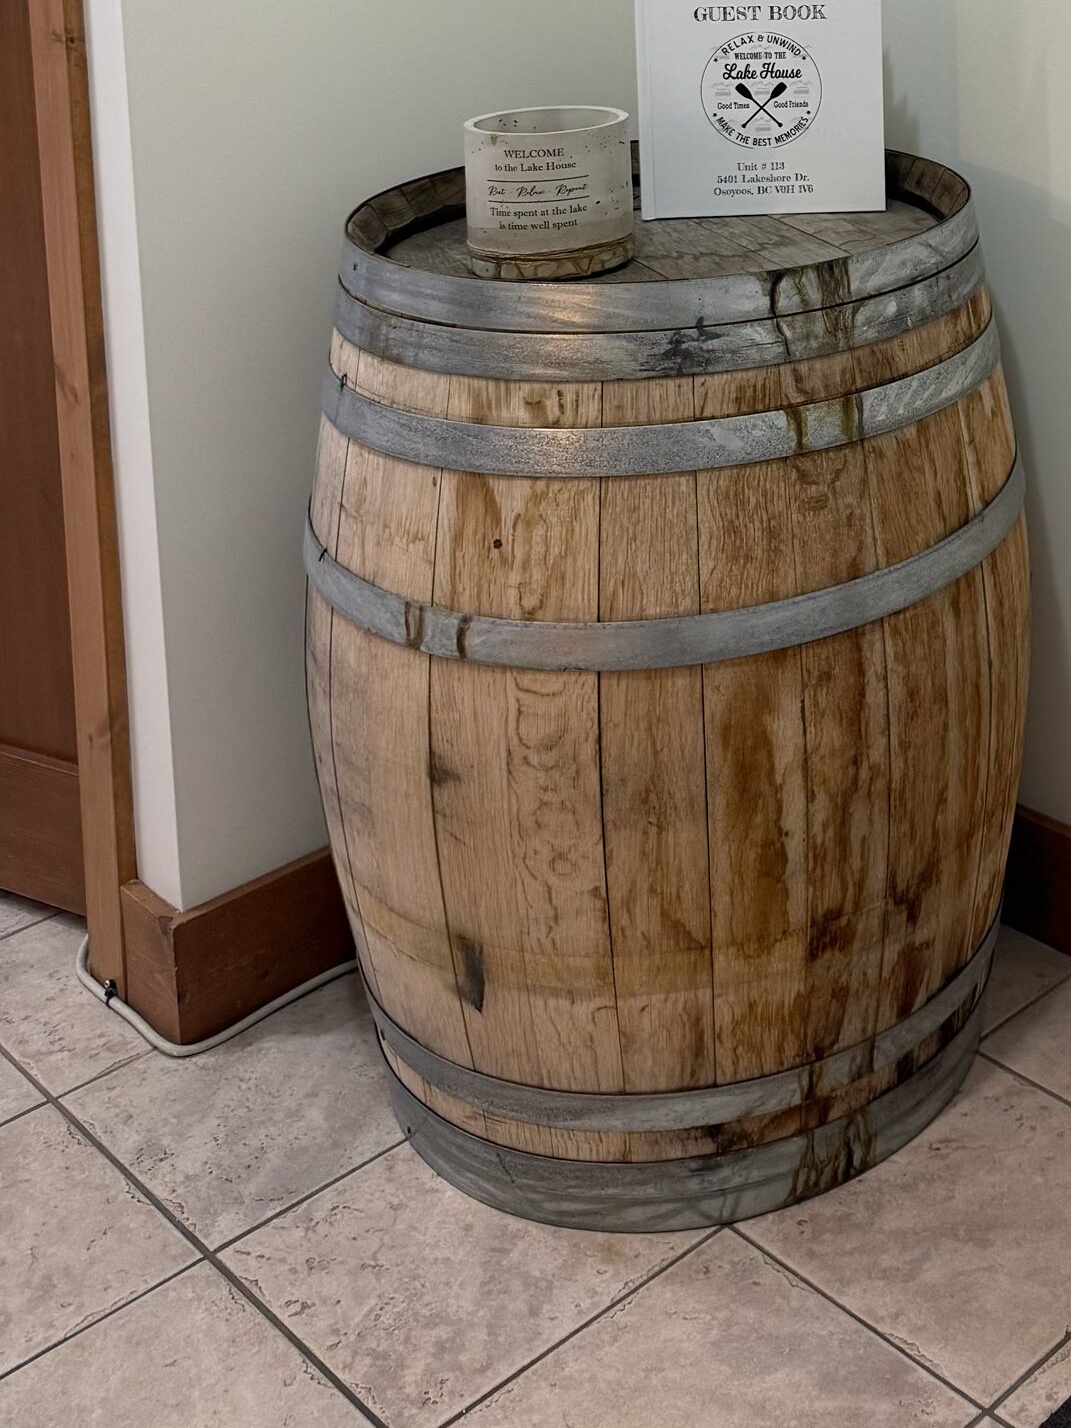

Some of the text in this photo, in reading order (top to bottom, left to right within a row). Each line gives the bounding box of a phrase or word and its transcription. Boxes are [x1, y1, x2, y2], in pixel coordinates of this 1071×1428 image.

[693, 4, 828, 22] GUEST BOOK
[721, 34, 754, 55] RELAX
[767, 34, 801, 56] UNWIND
[734, 52, 762, 60] WELCOME
[764, 52, 773, 60] TO
[722, 62, 802, 80] Lake House
[789, 100, 809, 108] Friends
[716, 116, 809, 146] MAKE THE BEST MEMORIES
[504, 148, 565, 159] WELCOME
[495, 162, 577, 172] to the Lake House
[737, 162, 758, 171] Unit
[770, 162, 785, 170] 113
[717, 173, 810, 183] 5401 Lakeshore Dr.
[713, 187, 754, 198] Osoyoos,
[757, 186, 772, 194] BC
[490, 207, 511, 217] Time
[513, 210, 538, 219] spent
[552, 207, 567, 215] the
[569, 204, 587, 213] lake
[499, 219, 578, 230] is time well spent
